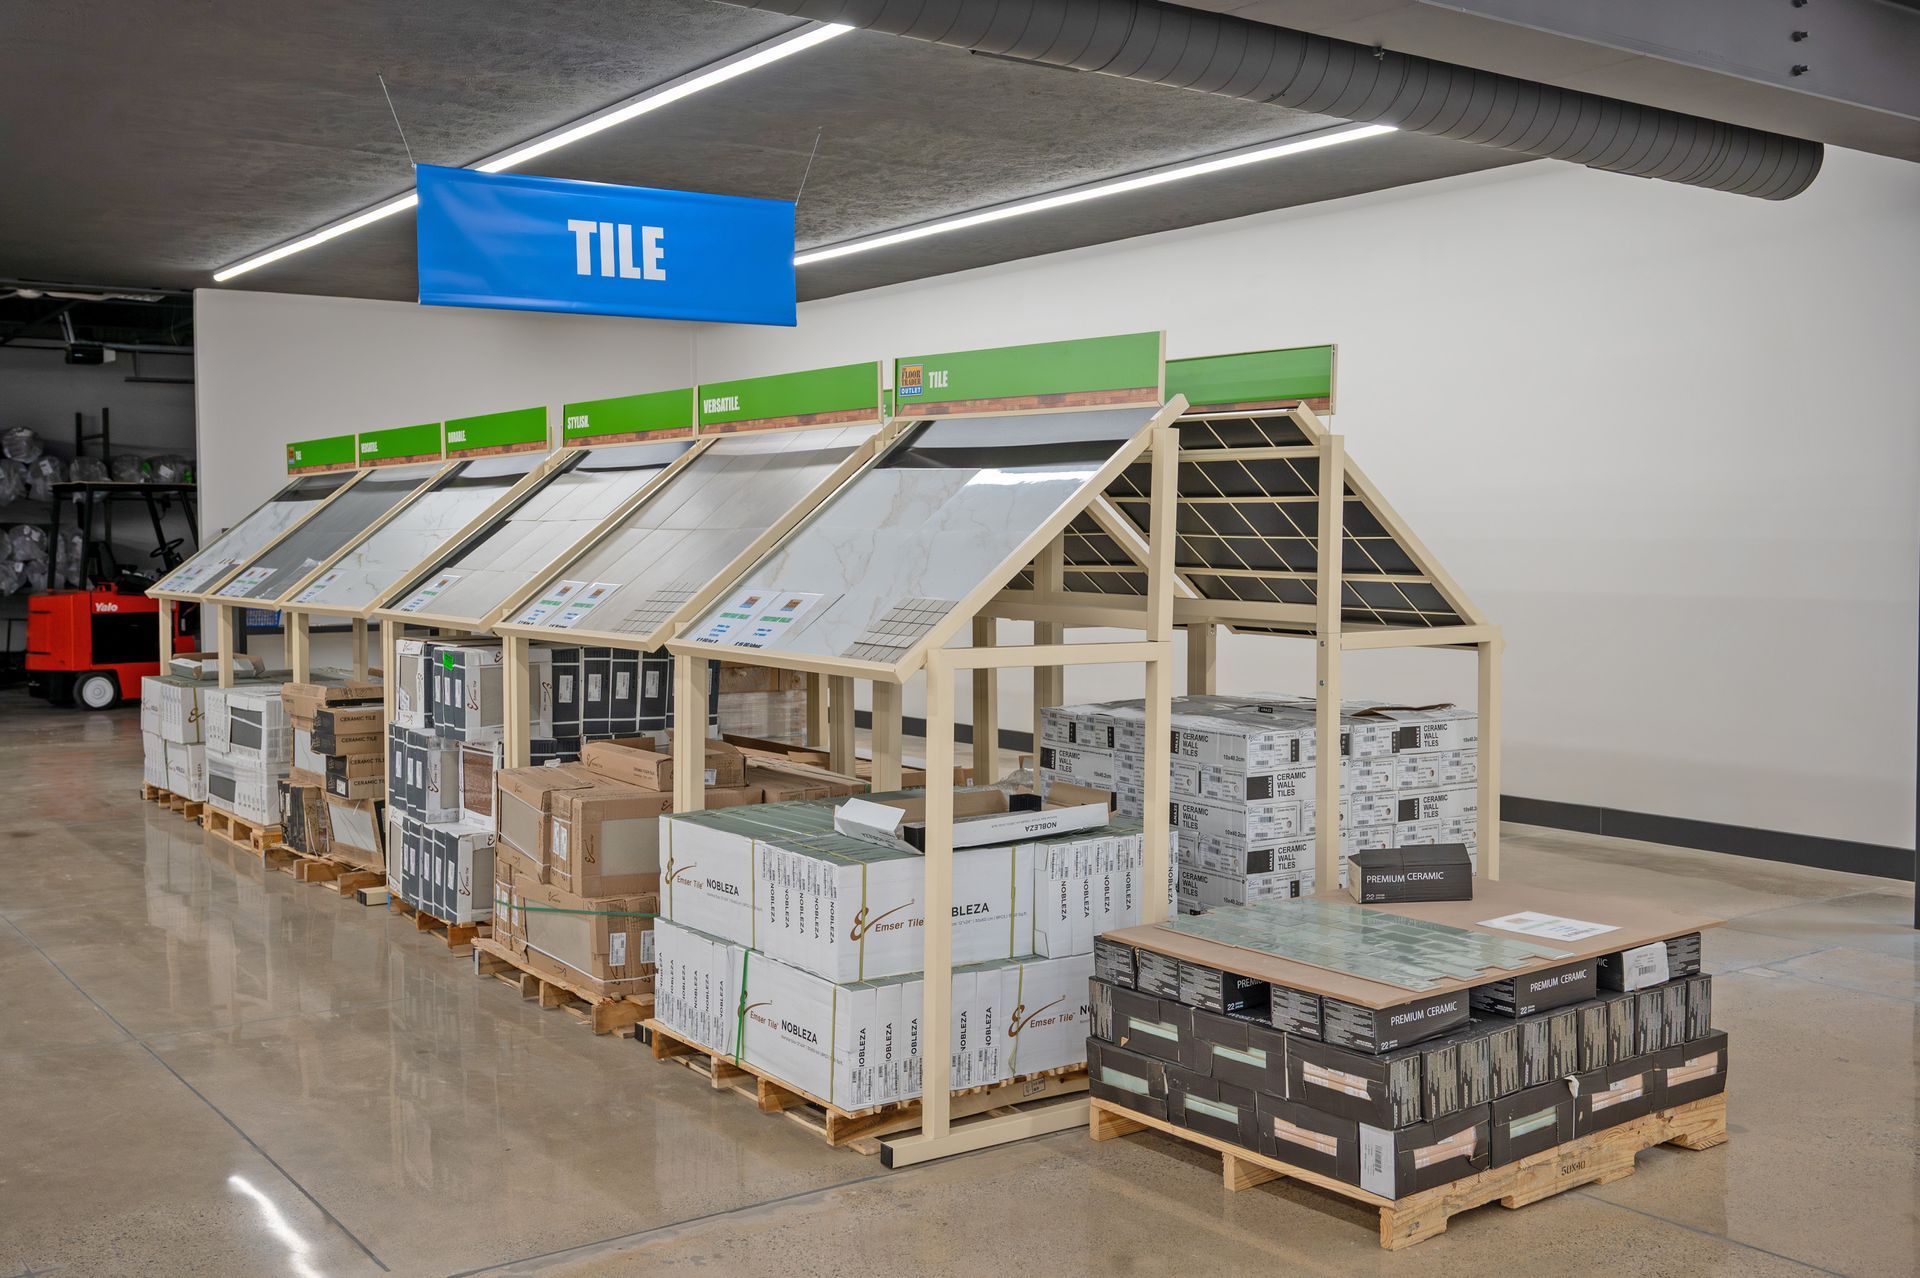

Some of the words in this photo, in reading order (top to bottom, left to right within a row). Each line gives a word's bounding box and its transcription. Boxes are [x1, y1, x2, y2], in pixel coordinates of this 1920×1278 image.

[567, 219, 666, 281] TILE
[901, 369, 921, 379] FLOOR
[928, 370, 949, 389] TILE
[703, 396, 740, 414] VERSATILE.
[567, 415, 590, 430] STYLISH.
[1423, 724, 1448, 732] CERAMIC
[1182, 732, 1209, 743] CERAMIC
[1182, 740, 1198, 749] WALL
[1423, 740, 1439, 748] TILES
[1058, 750, 1081, 760] CERAMIC
[1182, 747, 1198, 757] TILES
[1058, 758, 1073, 766] WALL
[1058, 765, 1073, 773] TILES
[1277, 771, 1307, 782] CERAMIC
[1277, 781, 1296, 789] WALL
[1277, 789, 1296, 798] TILES
[1423, 795, 1448, 804] CERAMIC
[1182, 804, 1209, 816] CERAMIC
[1182, 813, 1198, 822] WALL
[1025, 821, 1058, 832] NOBLEZA
[1182, 821, 1198, 830] TILES
[1278, 844, 1307, 855] CERAMIC
[1278, 854, 1296, 862] WALL
[1278, 862, 1296, 871] TILES
[677, 875, 692, 886] Emser
[693, 880, 703, 890] Tile
[1182, 871, 1208, 884] CERAMIC
[1366, 874, 1406, 883] PREMIUM
[1407, 871, 1444, 881] CERAMIC
[706, 877, 740, 896] NOBLEZA
[1182, 881, 1198, 890] WALL
[1182, 888, 1198, 897] TILES
[951, 902, 990, 918] BLEZA
[875, 921, 905, 933] Emser
[908, 918, 925, 928] Tile
[1530, 976, 1559, 992] PREMIUM
[1560, 969, 1587, 985] CERAMIC
[1227, 1002, 1235, 1010] 22
[1520, 1006, 1528, 1014] 22
[1390, 1010, 1425, 1027] PREMIUM
[1427, 1001, 1458, 1018] CERAMIC
[750, 1010, 766, 1025] Emser
[767, 1018, 777, 1030] Tile
[1030, 1017, 1055, 1029] Emser
[1059, 1013, 1074, 1023] Tile
[781, 1018, 818, 1044] NOBLEZA
[1380, 1041, 1389, 1050] 22
[1561, 1160, 1586, 1176] 50X40
